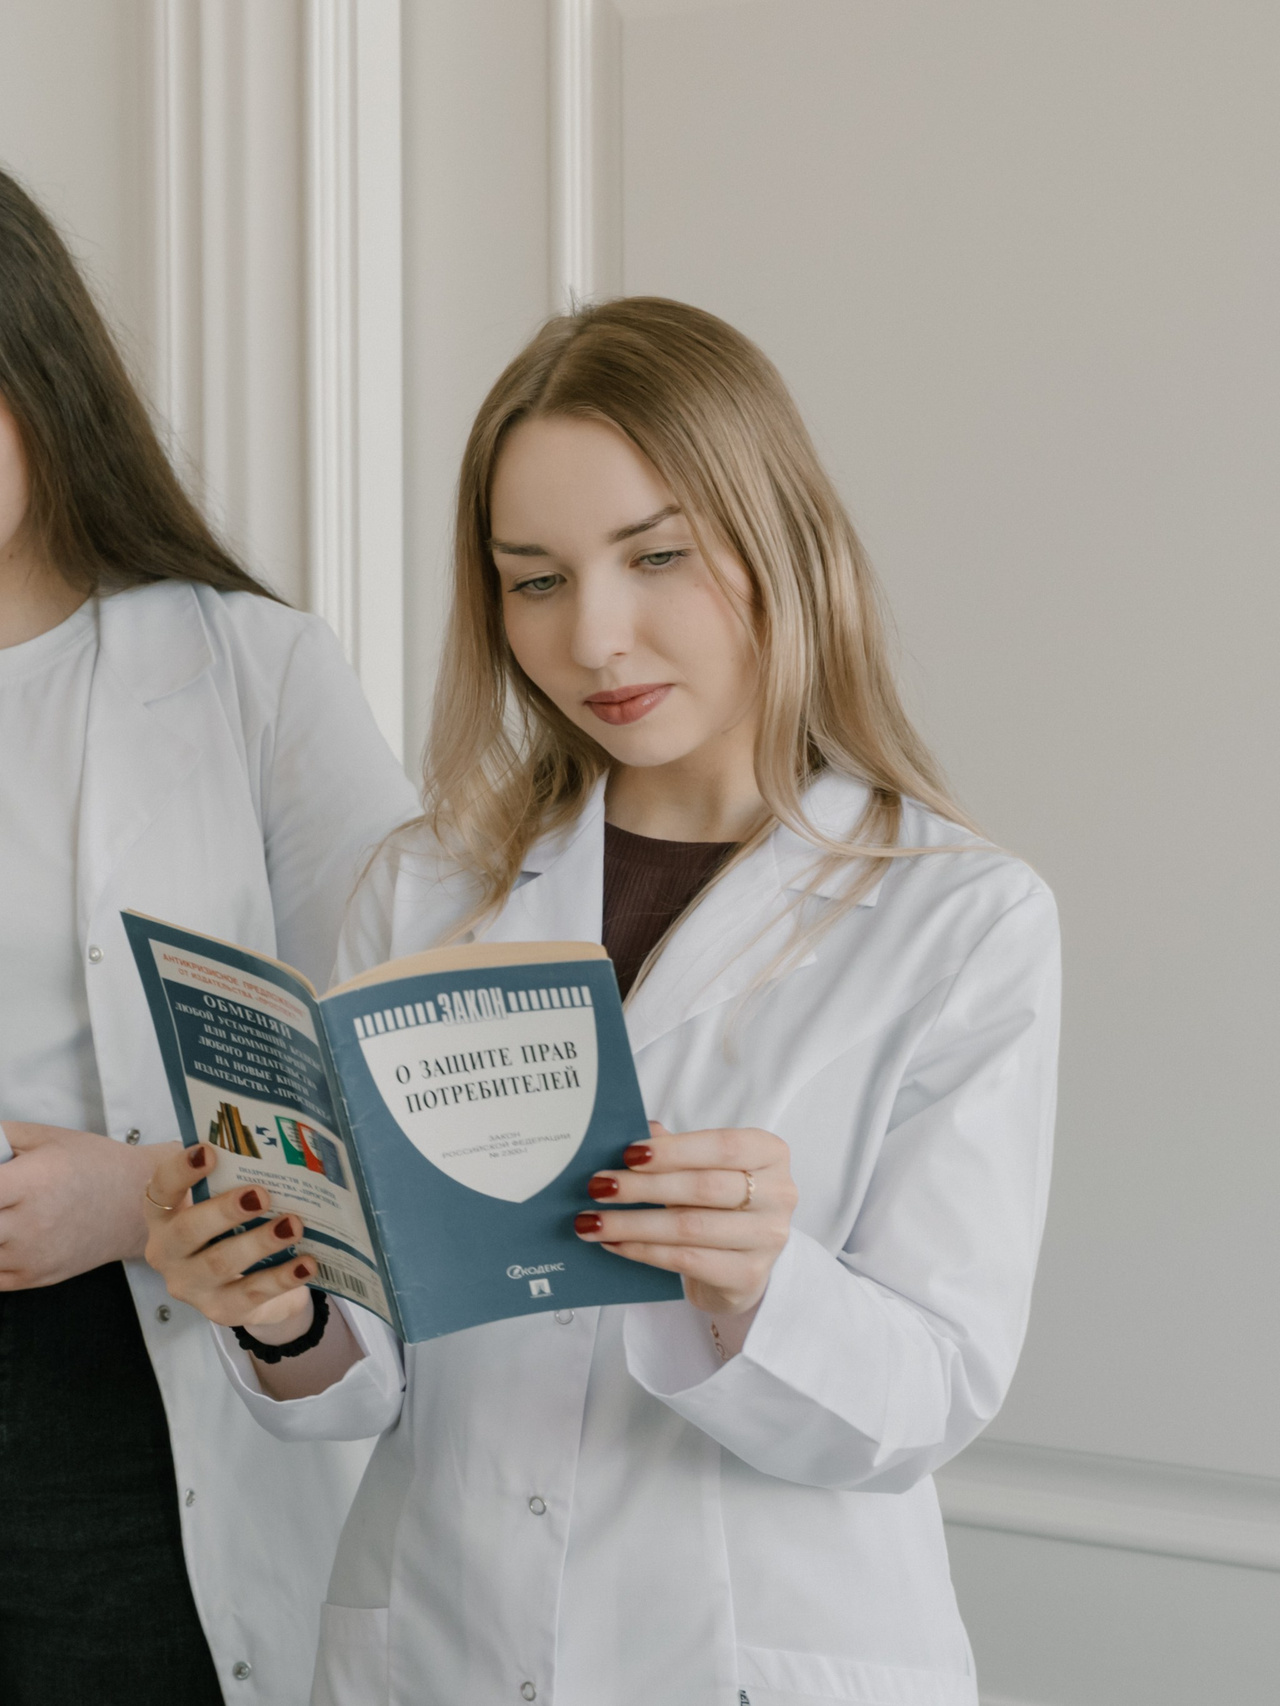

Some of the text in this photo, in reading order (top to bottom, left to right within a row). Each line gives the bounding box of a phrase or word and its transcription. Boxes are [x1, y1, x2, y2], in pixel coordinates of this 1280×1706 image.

[162, 953, 238, 985] АНТИКРИЗИСНОЕ
[178, 968, 189, 977] ОТ
[191, 973, 253, 1000] ИЗДАТЕЛЬСТВА
[175, 1002, 214, 1022] ЛЮБОЙ
[217, 1015, 286, 1050] УСТАРЕВШИЙ
[203, 994, 293, 1040] ОБМЕНЯЙ
[437, 987, 508, 1026] ЗАКОН
[198, 1035, 318, 1091] ЛЮБОГО ИЗДАТЕЛЬСТВА
[204, 1023, 307, 1073] ИЛИ КОММЕНТАРИЙ
[396, 1041, 578, 1085] О ЗАЩИТЕ ПРАВ
[194, 1060, 270, 1094] ИЗДАТЕЛЬСТВА
[215, 1054, 309, 1096] НА НОВЫЕ КНИГИ
[405, 1066, 581, 1114] ПОТРЕБИТЕЛЕЙ
[442, 1132, 571, 1159] РОССИЙСКОЙ ФЕДЕРАЦИИ
[489, 1131, 521, 1142] ЗАКОН
[236, 1174, 297, 1192] ИЗДАТЕЛЬСТВА
[238, 1166, 299, 1185] ПОДРОБНОСТИ
